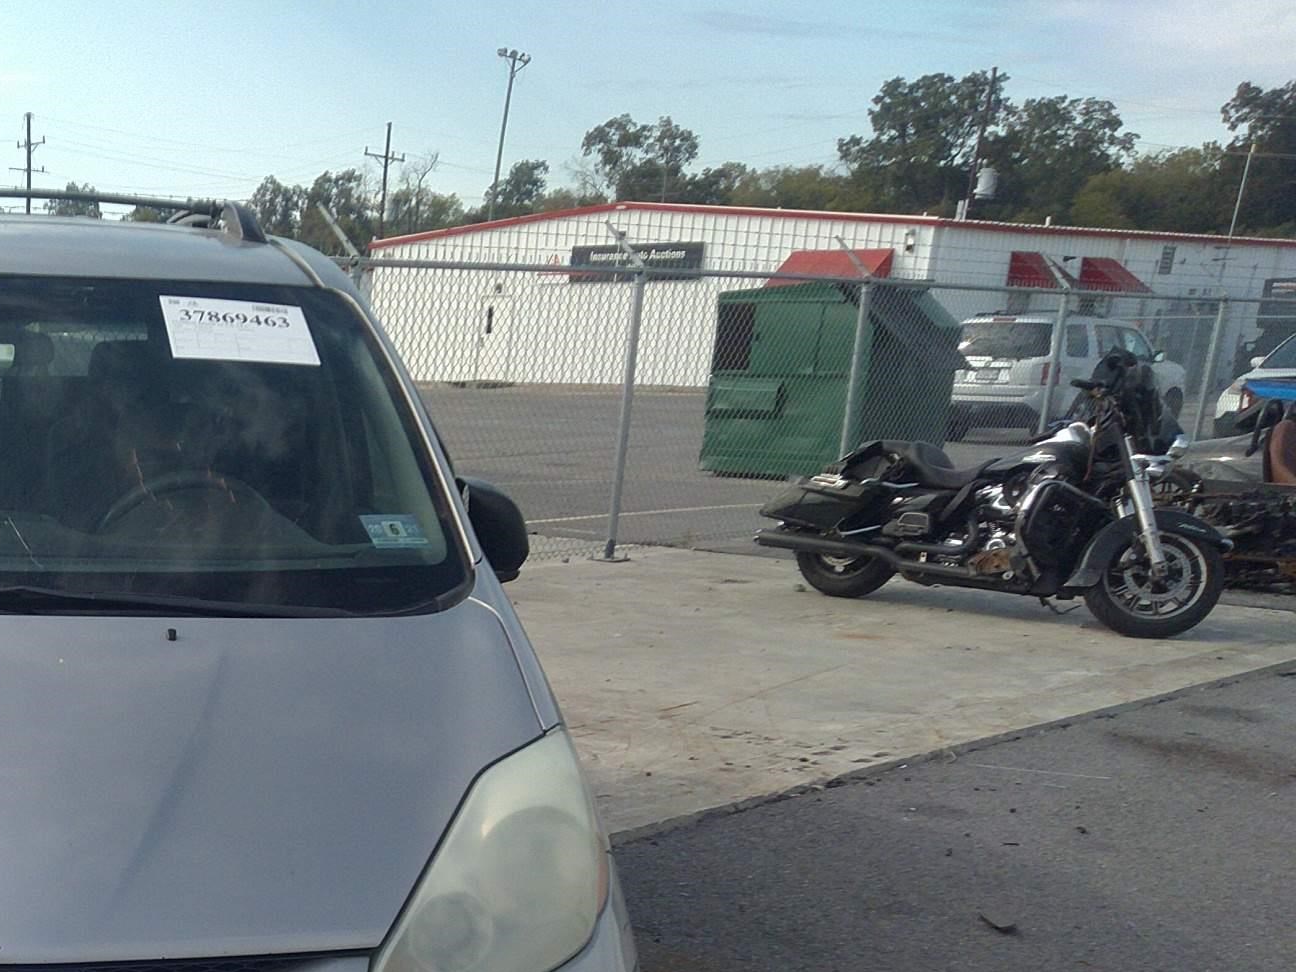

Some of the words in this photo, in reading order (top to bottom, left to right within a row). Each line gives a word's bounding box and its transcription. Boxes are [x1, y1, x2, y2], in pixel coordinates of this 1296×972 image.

[589, 250, 629, 261] Insurance
[649, 248, 686, 260] Auctions
[179, 308, 291, 329] 37869463
